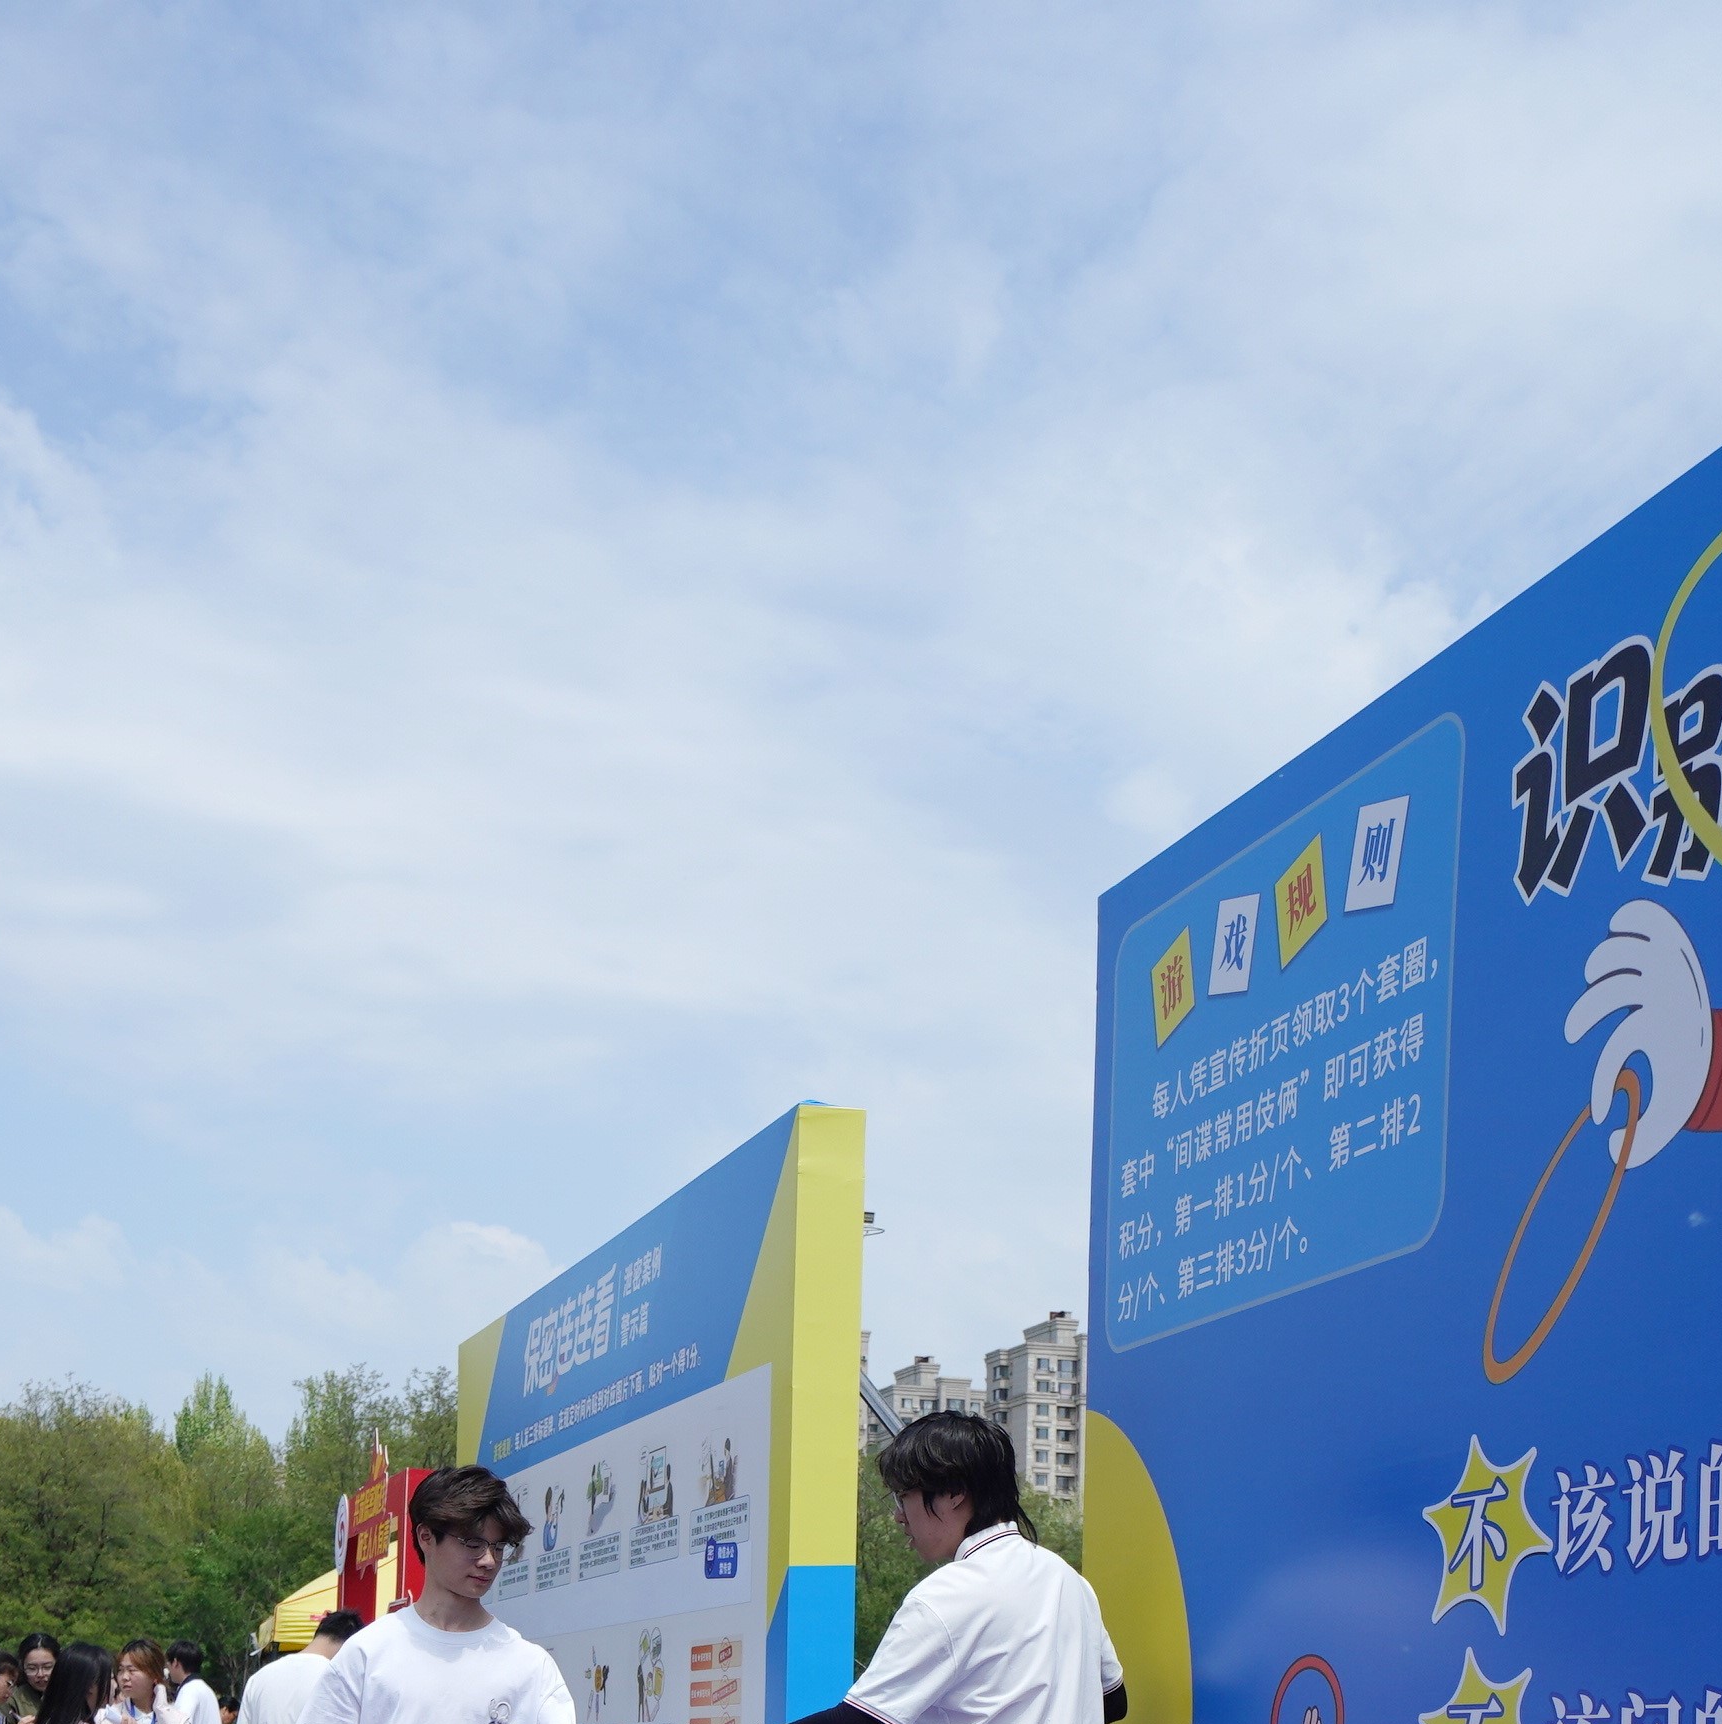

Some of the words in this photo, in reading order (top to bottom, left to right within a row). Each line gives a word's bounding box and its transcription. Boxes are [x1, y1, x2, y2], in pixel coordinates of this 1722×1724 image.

[1158, 815, 1397, 1022] 游戏规则
[1151, 936, 1439, 1121] 每人凭宣传折页领取3个套圈，
[523, 1262, 618, 1398] 保密连连看
[1116, 1214, 1310, 1324] 分/个、第三排3分/个。
